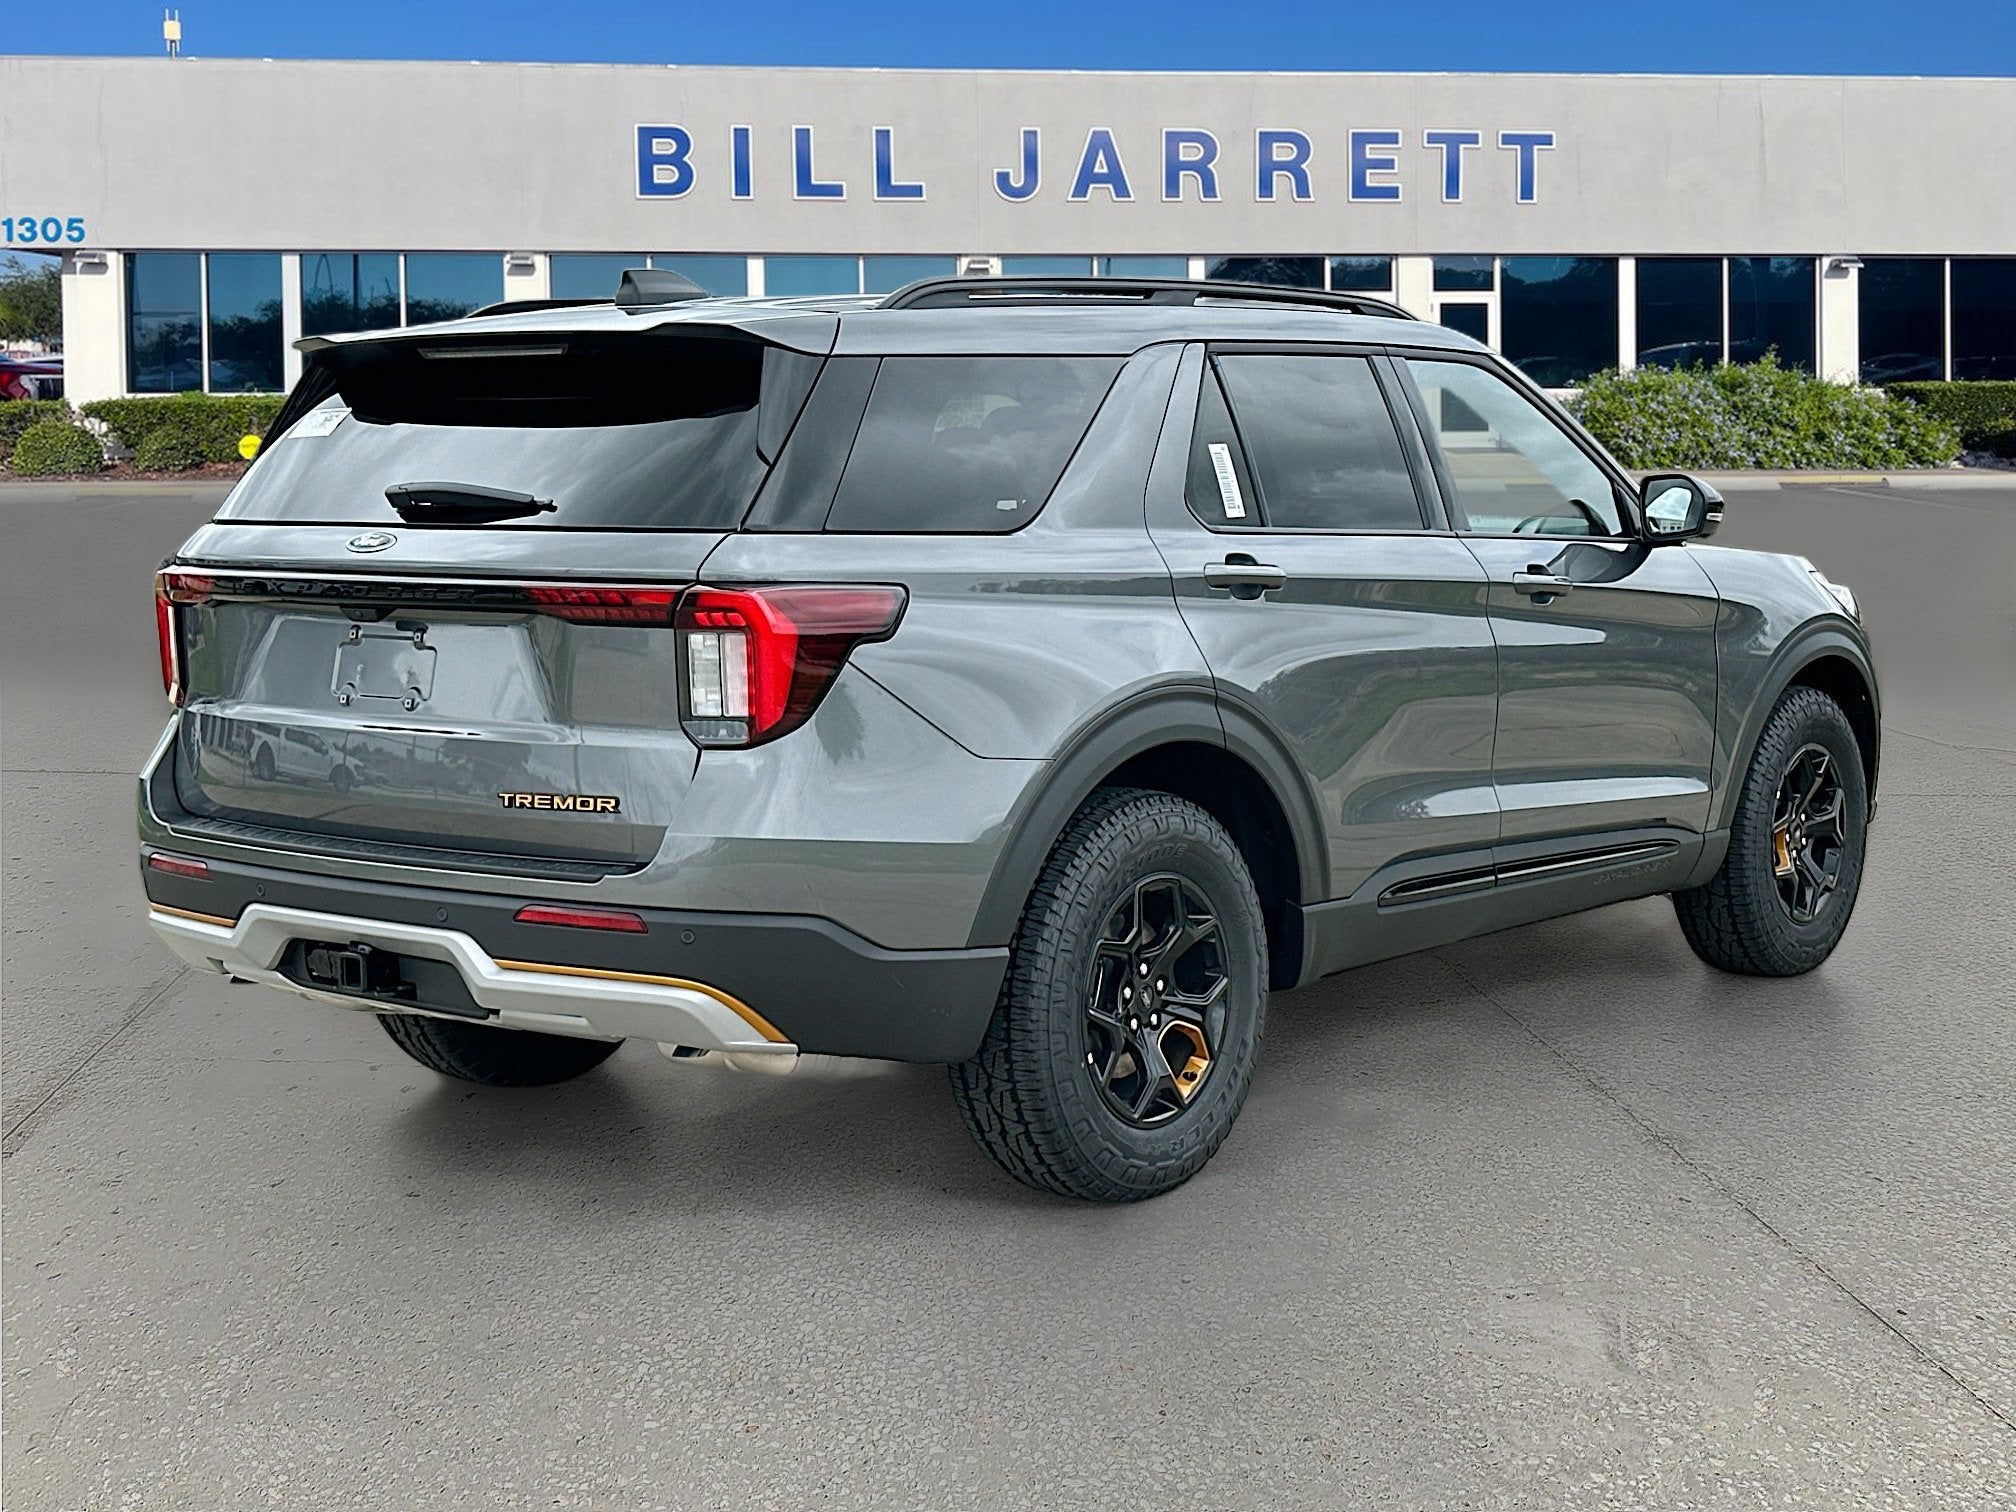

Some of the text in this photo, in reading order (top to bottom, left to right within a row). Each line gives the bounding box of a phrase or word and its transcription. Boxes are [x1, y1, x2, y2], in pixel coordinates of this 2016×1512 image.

[635, 123, 1556, 204] BILL JARRETT
[1, 216, 86, 243] 1305
[498, 791, 620, 814] TREMOR
